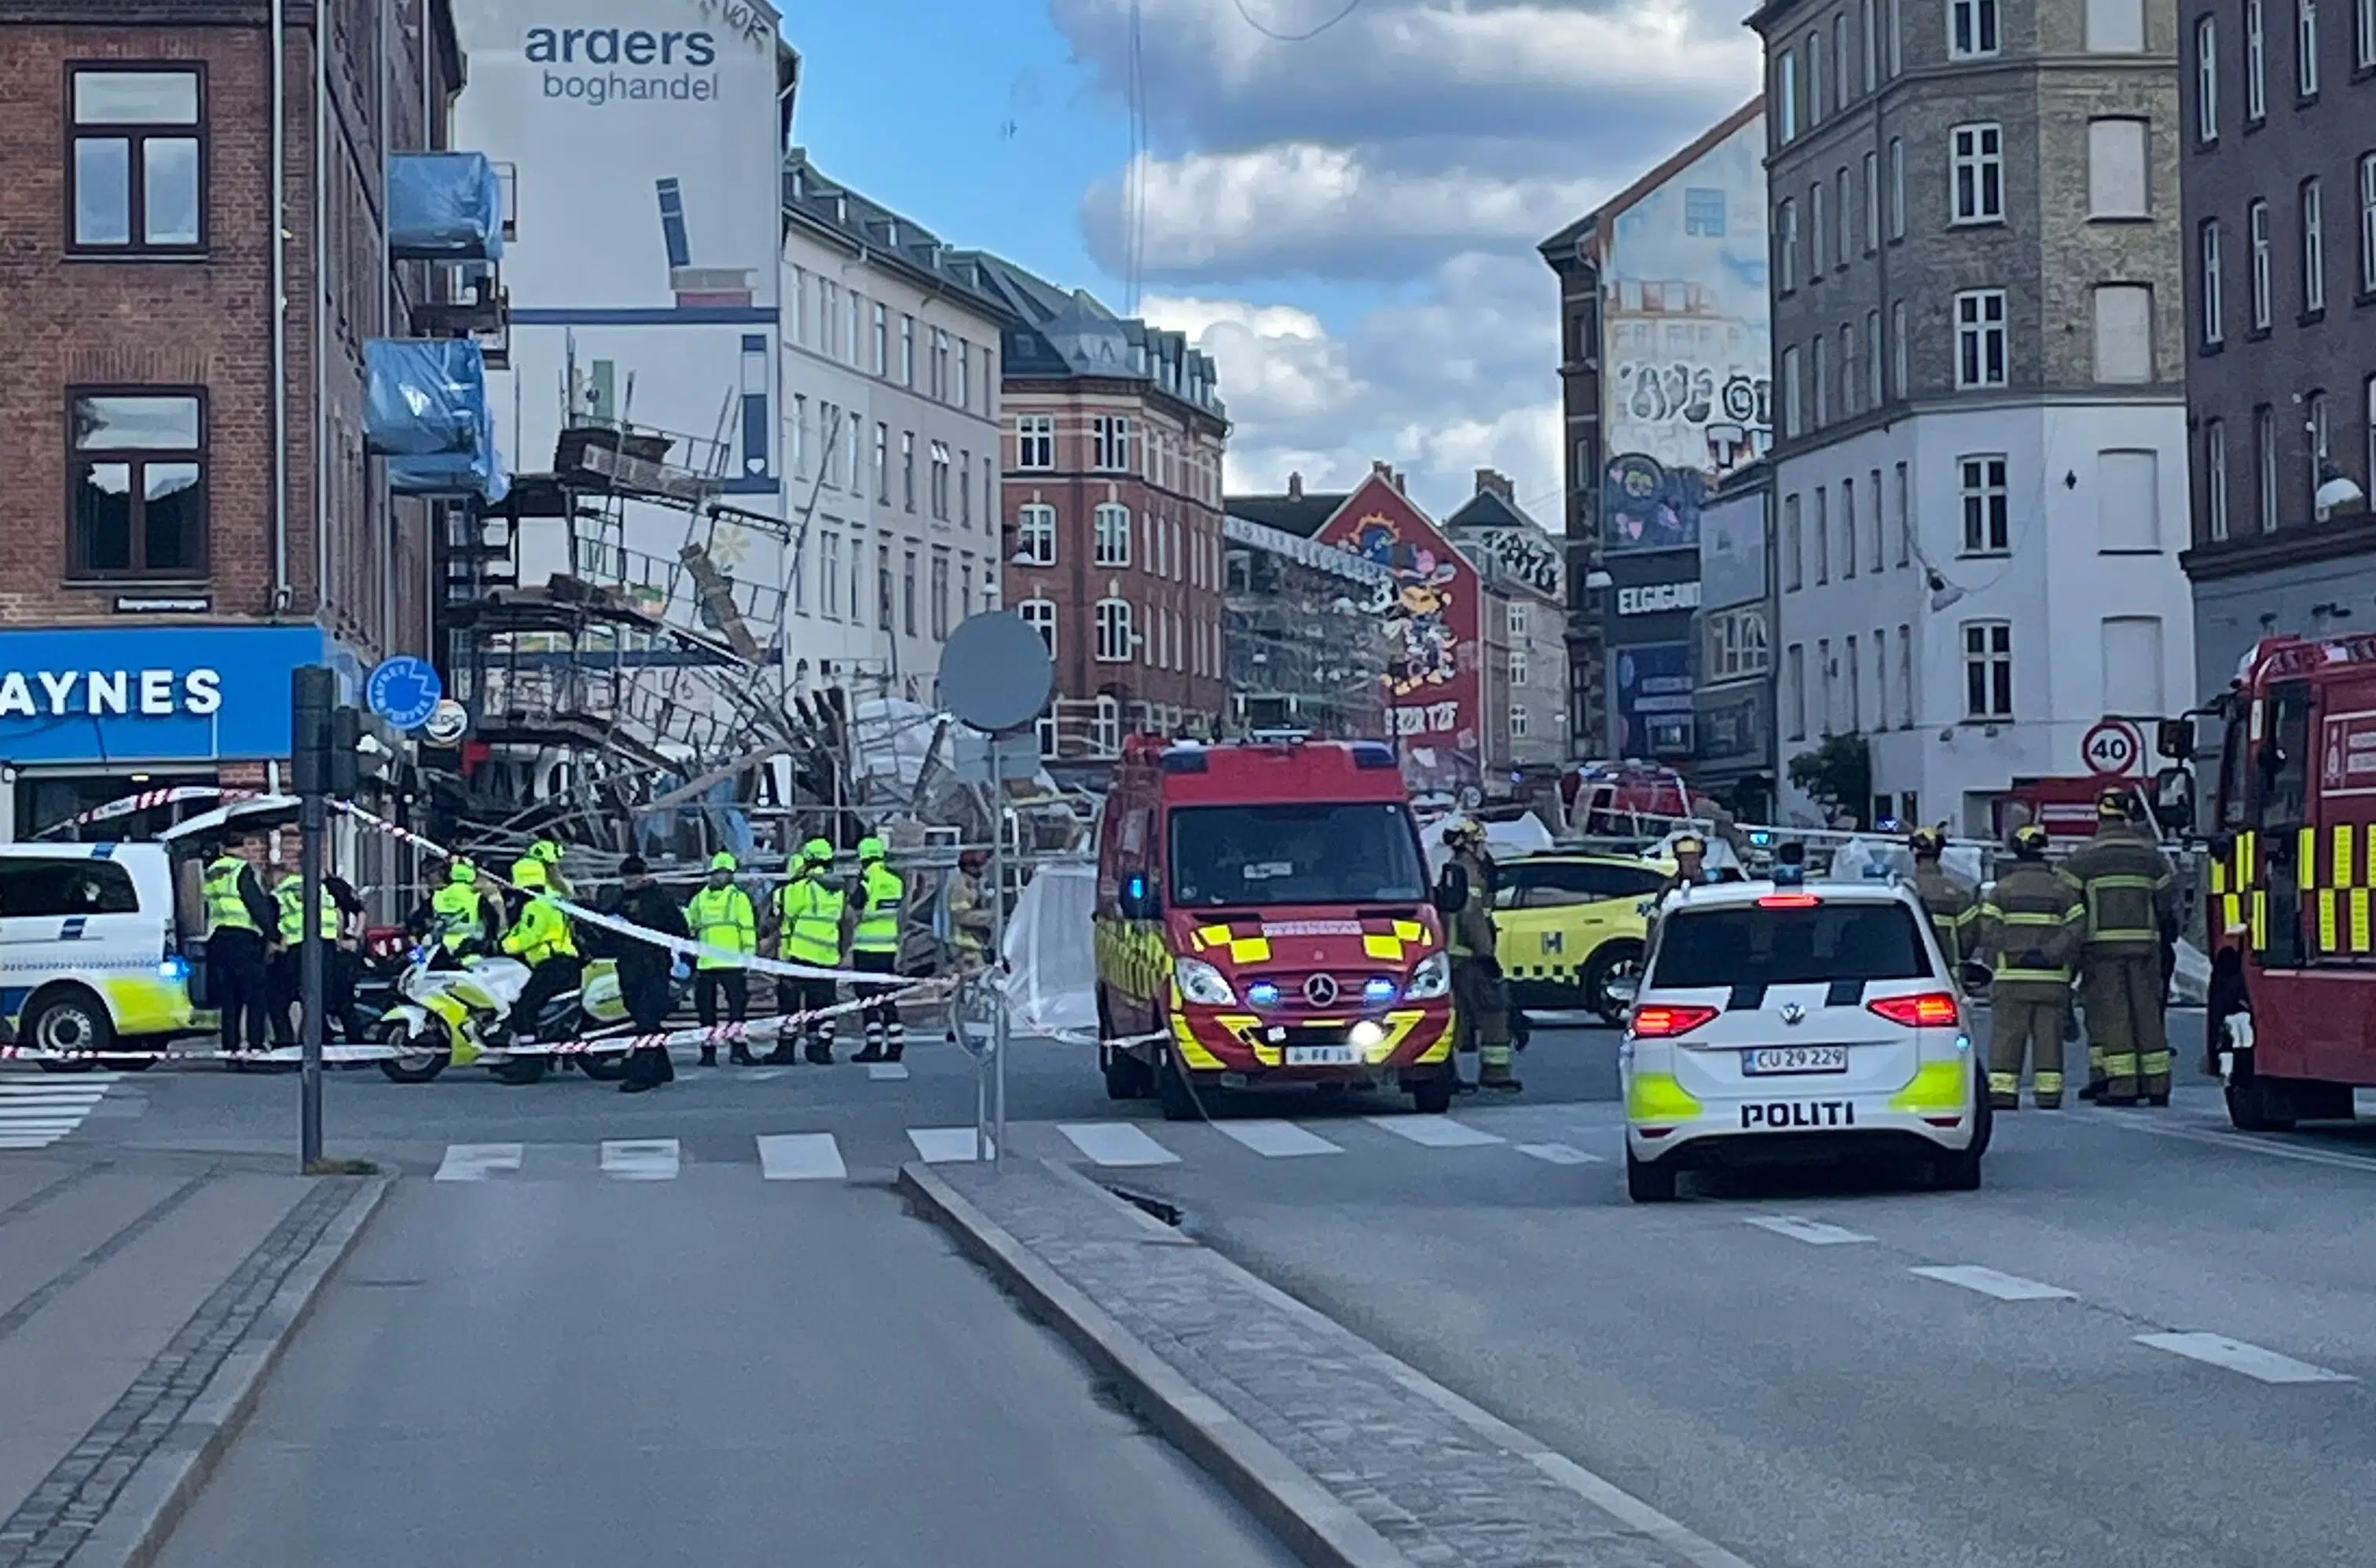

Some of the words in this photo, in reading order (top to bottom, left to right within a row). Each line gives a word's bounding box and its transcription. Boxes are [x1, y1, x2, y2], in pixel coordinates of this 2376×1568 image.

[543, 69, 718, 105] boghandel
[0, 669, 222, 716] AYNES
[2091, 738, 2126, 760] 40
[1741, 1101, 1854, 1128] POLITI
